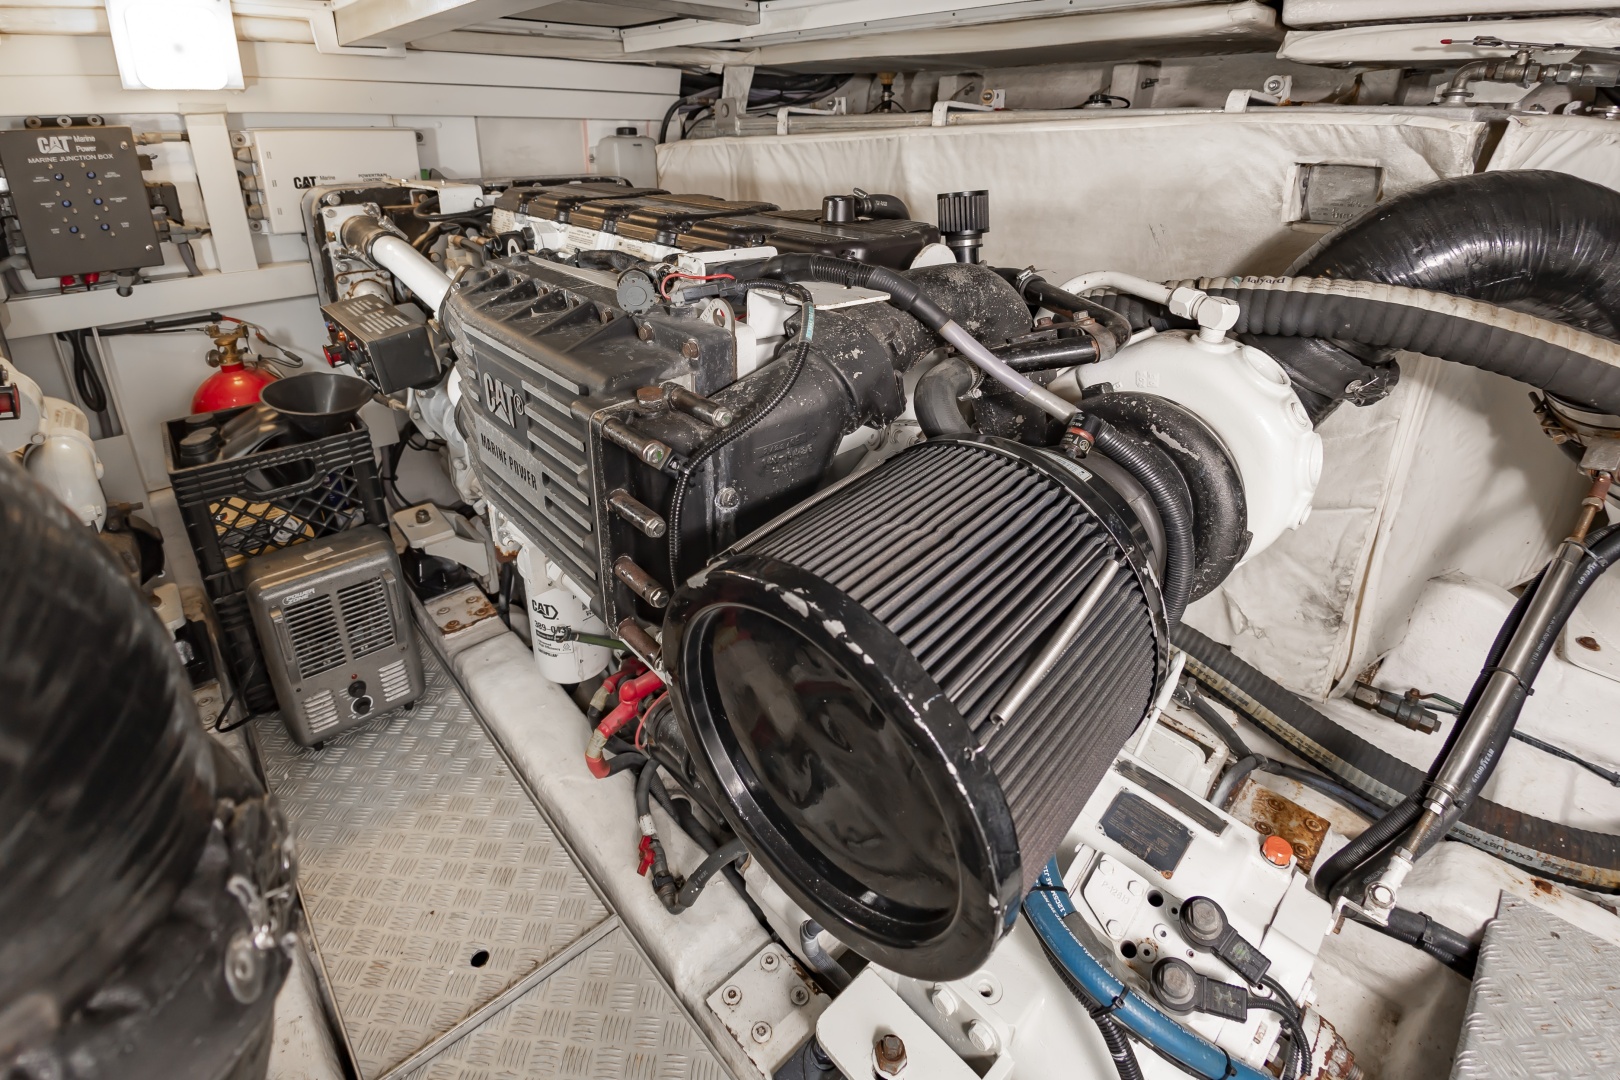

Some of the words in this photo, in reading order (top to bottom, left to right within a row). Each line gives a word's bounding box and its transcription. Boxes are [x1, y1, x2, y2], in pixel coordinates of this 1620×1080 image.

[37, 136, 73, 154] CAT
[74, 135, 95, 143] Marine
[28, 156, 58, 164] MARINE
[59, 154, 96, 162] JUNCTION
[293, 176, 316, 189] CAT
[1241, 277, 1285, 286] Halyard
[484, 372, 515, 428] CAT
[480, 432, 507, 466] MARINE
[509, 455, 537, 490] POWER
[532, 600, 553, 617] CAT
[1472, 748, 1495, 784] GOODYEAR
[1451, 828, 1481, 842] HOSE
[1485, 839, 1533, 862] EXHAUST
